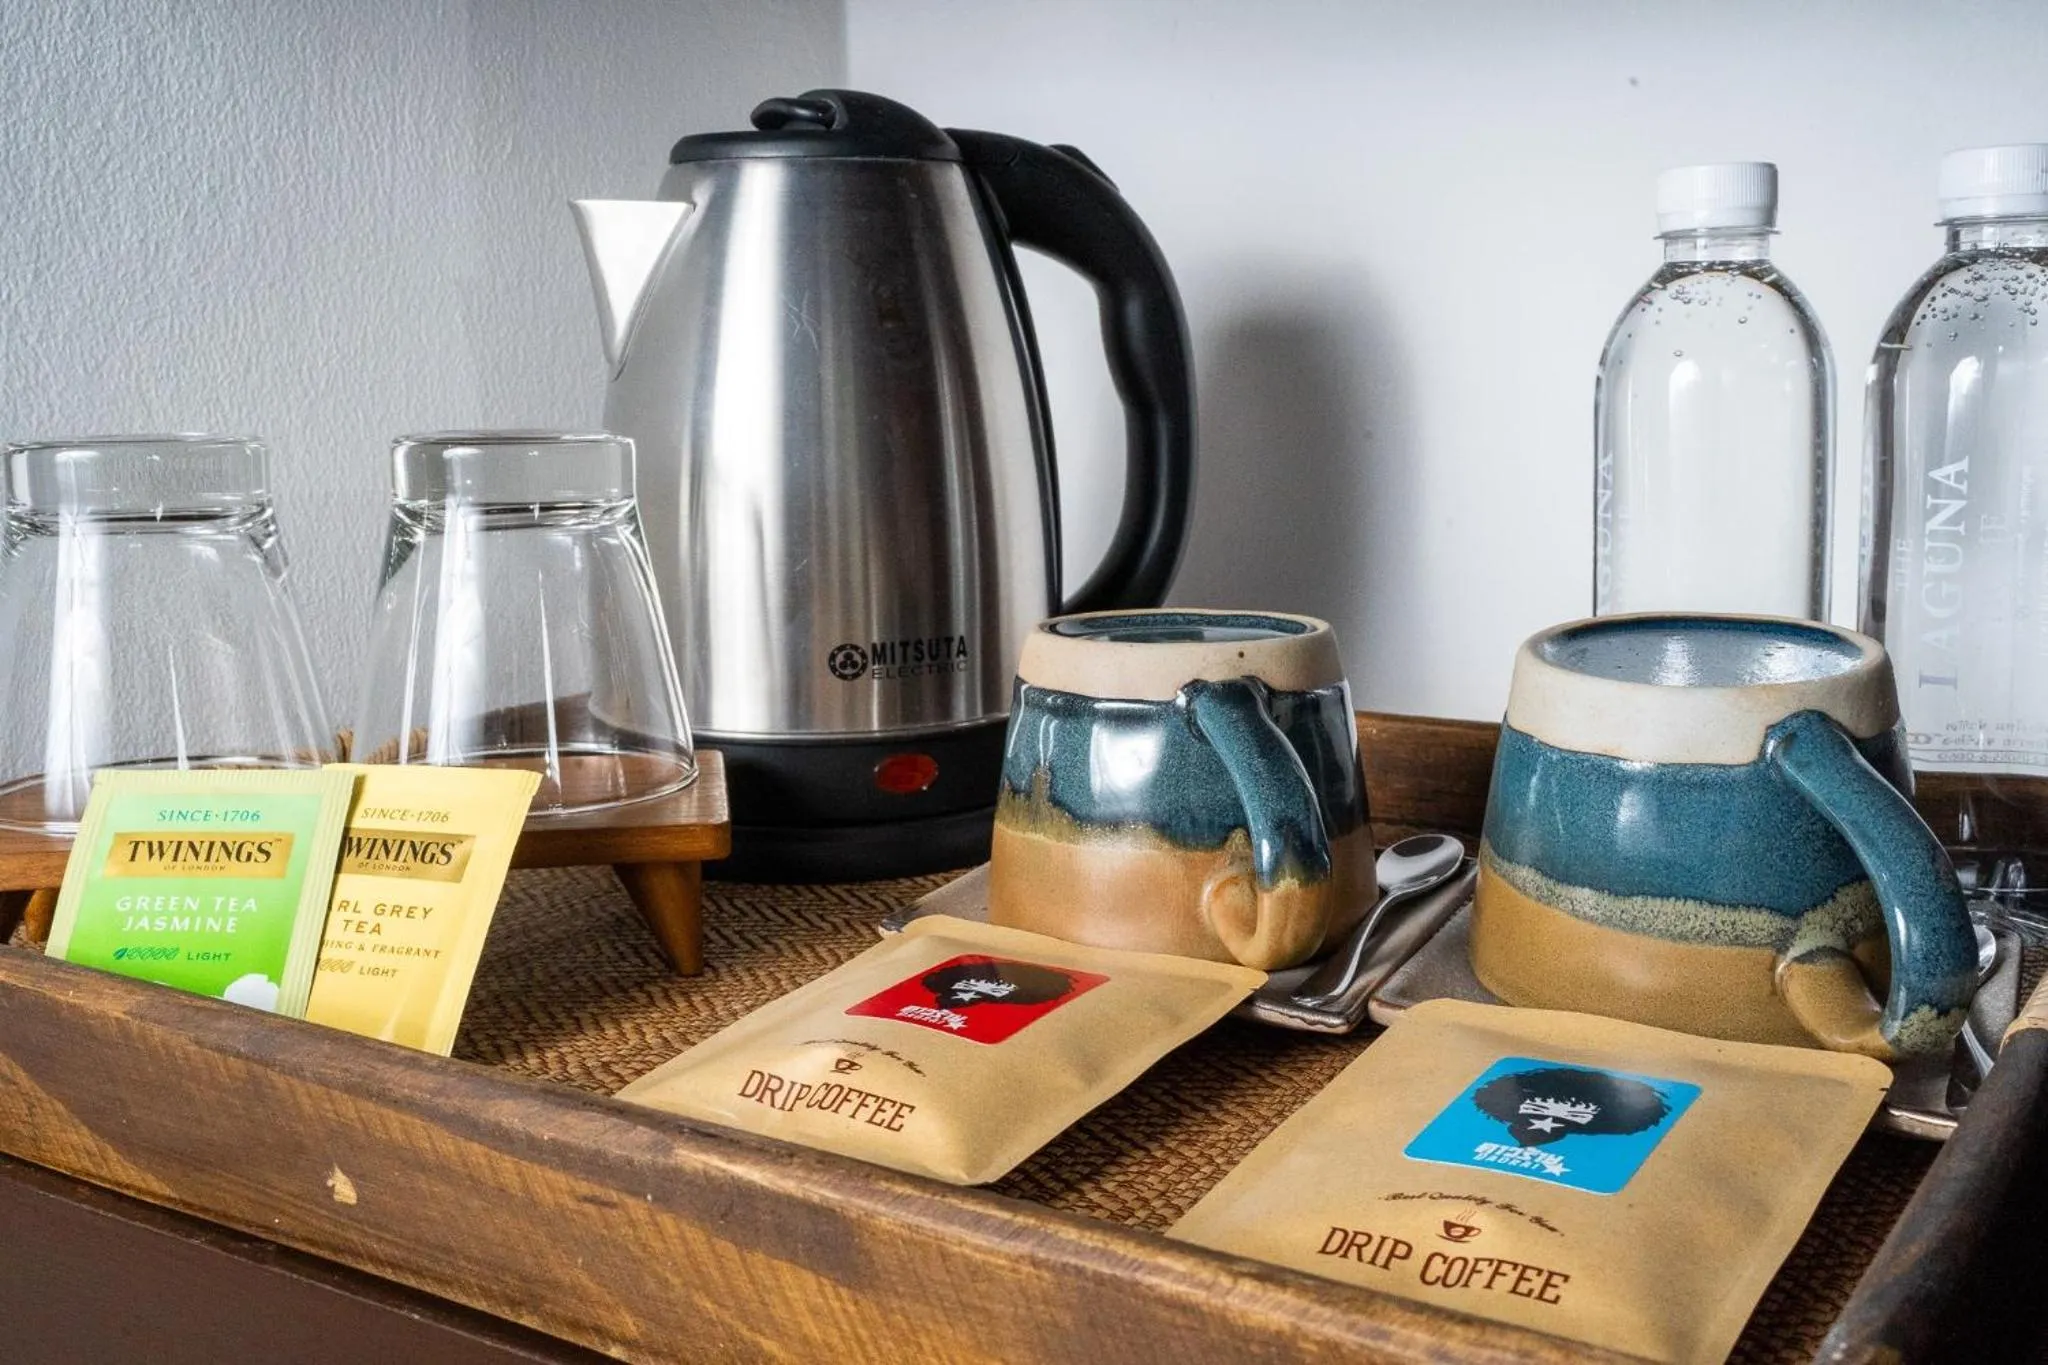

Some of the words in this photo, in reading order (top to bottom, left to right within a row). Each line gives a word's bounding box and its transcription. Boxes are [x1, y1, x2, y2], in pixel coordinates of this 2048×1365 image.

[871, 635, 968, 666] MITSUTA
[871, 660, 967, 680] ELECTRIC
[344, 836, 456, 867] WININGS
[181, 864, 227, 872] LONDON
[371, 863, 412, 873] LONDON
[115, 895, 200, 912] GREEN
[214, 896, 258, 913] TEA
[373, 902, 433, 921] GREY
[121, 915, 239, 934] JASMINE
[342, 918, 382, 936] TEA
[186, 951, 232, 962] LIGHT
[371, 943, 441, 960] FRAGRANT
[359, 964, 398, 979] LIGHT
[737, 1068, 813, 1113] DRIP
[806, 1081, 916, 1133] COFFEE
[1317, 1225, 1414, 1271] DRIP
[1419, 1251, 1571, 1305] COFFEE
